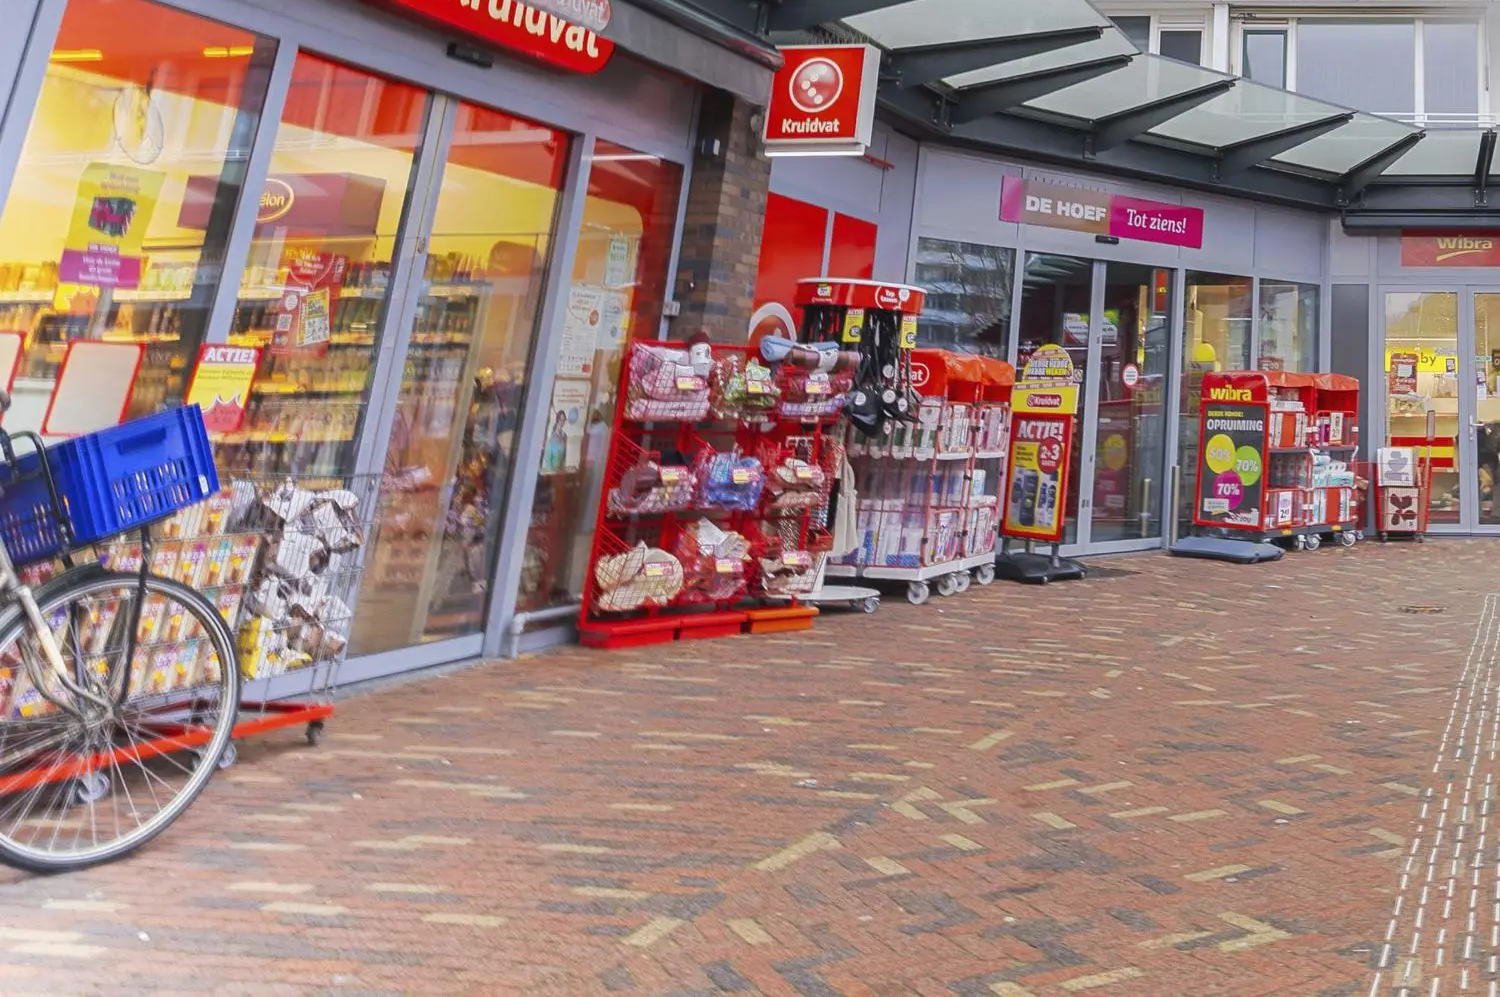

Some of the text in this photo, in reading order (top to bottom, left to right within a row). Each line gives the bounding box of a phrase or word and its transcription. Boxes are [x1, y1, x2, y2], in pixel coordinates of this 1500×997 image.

[781, 118, 840, 133] Kruidvat
[1025, 195, 1107, 222] DE HOEF
[1126, 208, 1187, 234] Tot ziens!
[1436, 234, 1493, 250] Wibra
[203, 346, 257, 363] ACTIE!
[1018, 420, 1064, 441] ACTIE!
[1206, 418, 1263, 431] OPRUIMING
[1236, 459, 1258, 472] 70%
[1217, 482, 1240, 496] 70%
